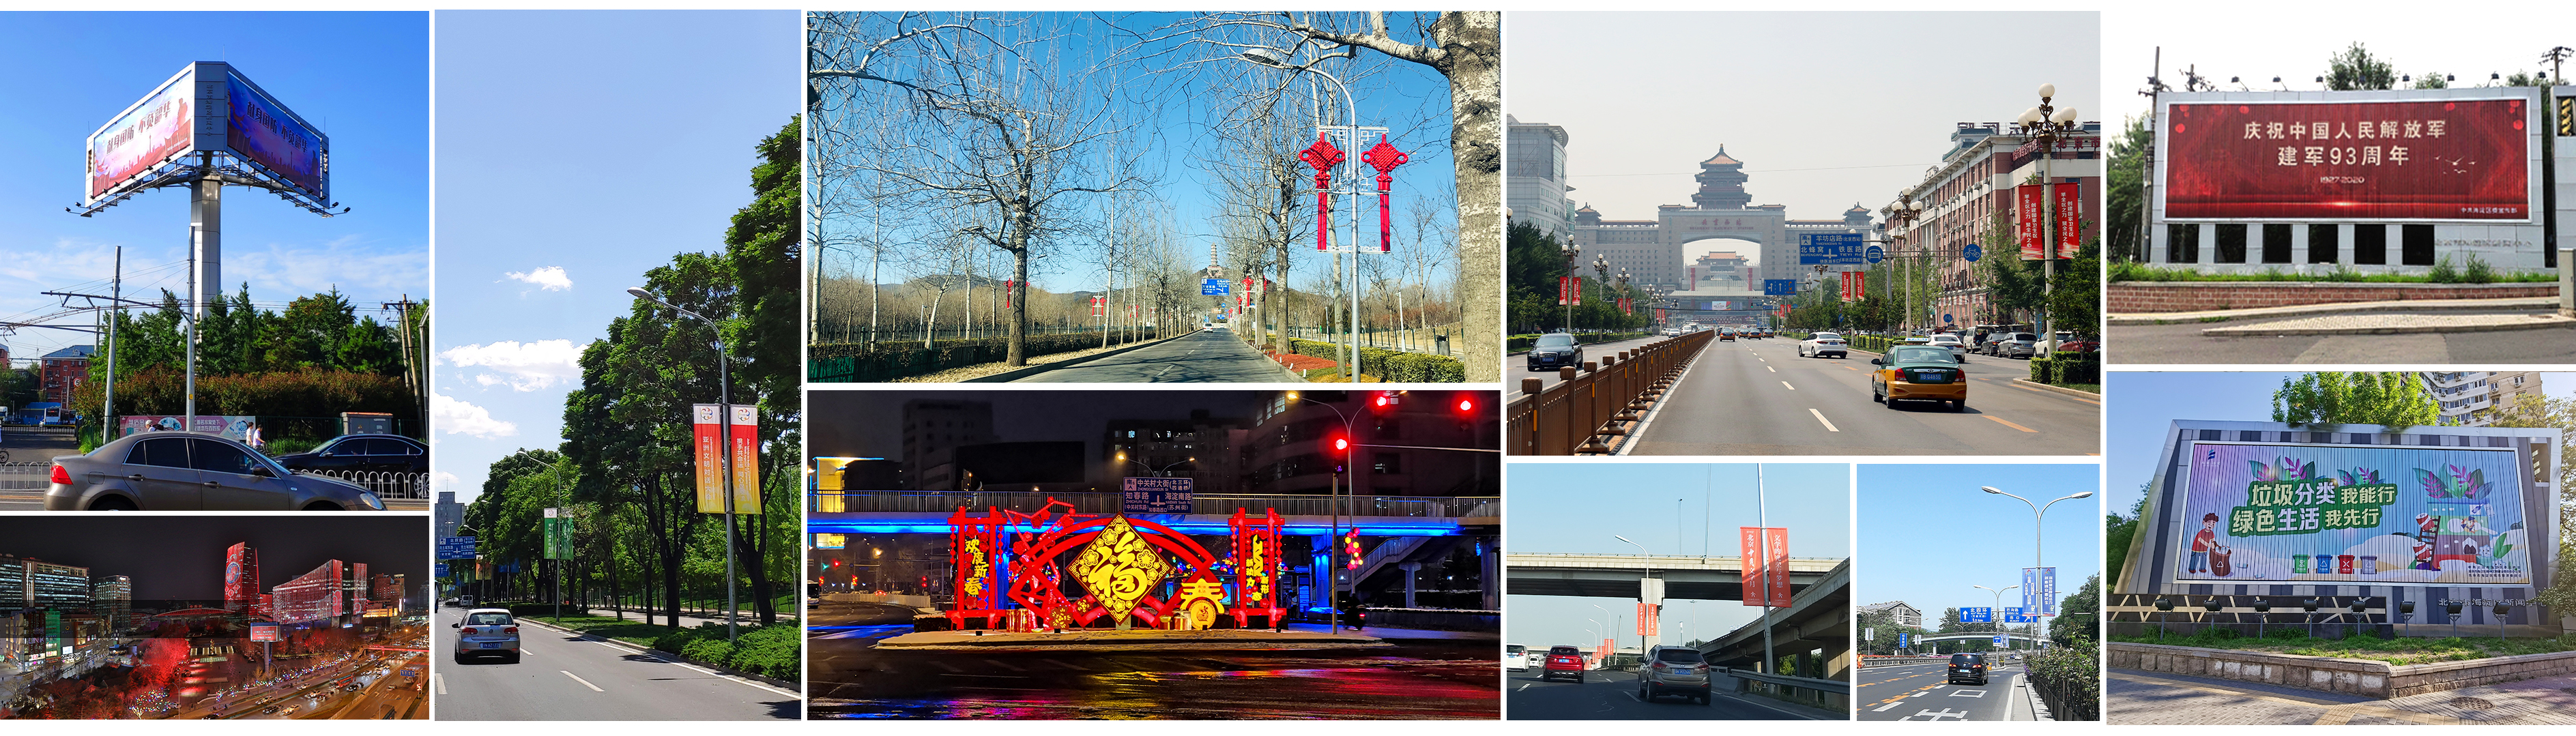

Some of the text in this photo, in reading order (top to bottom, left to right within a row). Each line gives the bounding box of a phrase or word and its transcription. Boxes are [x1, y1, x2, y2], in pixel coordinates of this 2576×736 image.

[106, 124, 134, 154] 献身国防
[139, 101, 172, 134] 不负韶华
[247, 102, 308, 153] 献身国防 不负韶华
[2244, 120, 2446, 140] 庆祝中国人民解放军
[2278, 145, 2409, 166] 建军93周年
[702, 436, 712, 500] 亚洲文明对话大会
[1138, 479, 1169, 487] 中关村大街
[1125, 492, 1149, 500] 知春路
[2251, 482, 2395, 507] 垃圾分类 我能行
[2232, 507, 2379, 533] 绿色生活 我先行
[964, 539, 989, 595] 欢度新春
[1088, 531, 1147, 600] 福
[1774, 534, 1783, 588] 文学的光荣与梦想
[1180, 578, 1224, 614] 春
